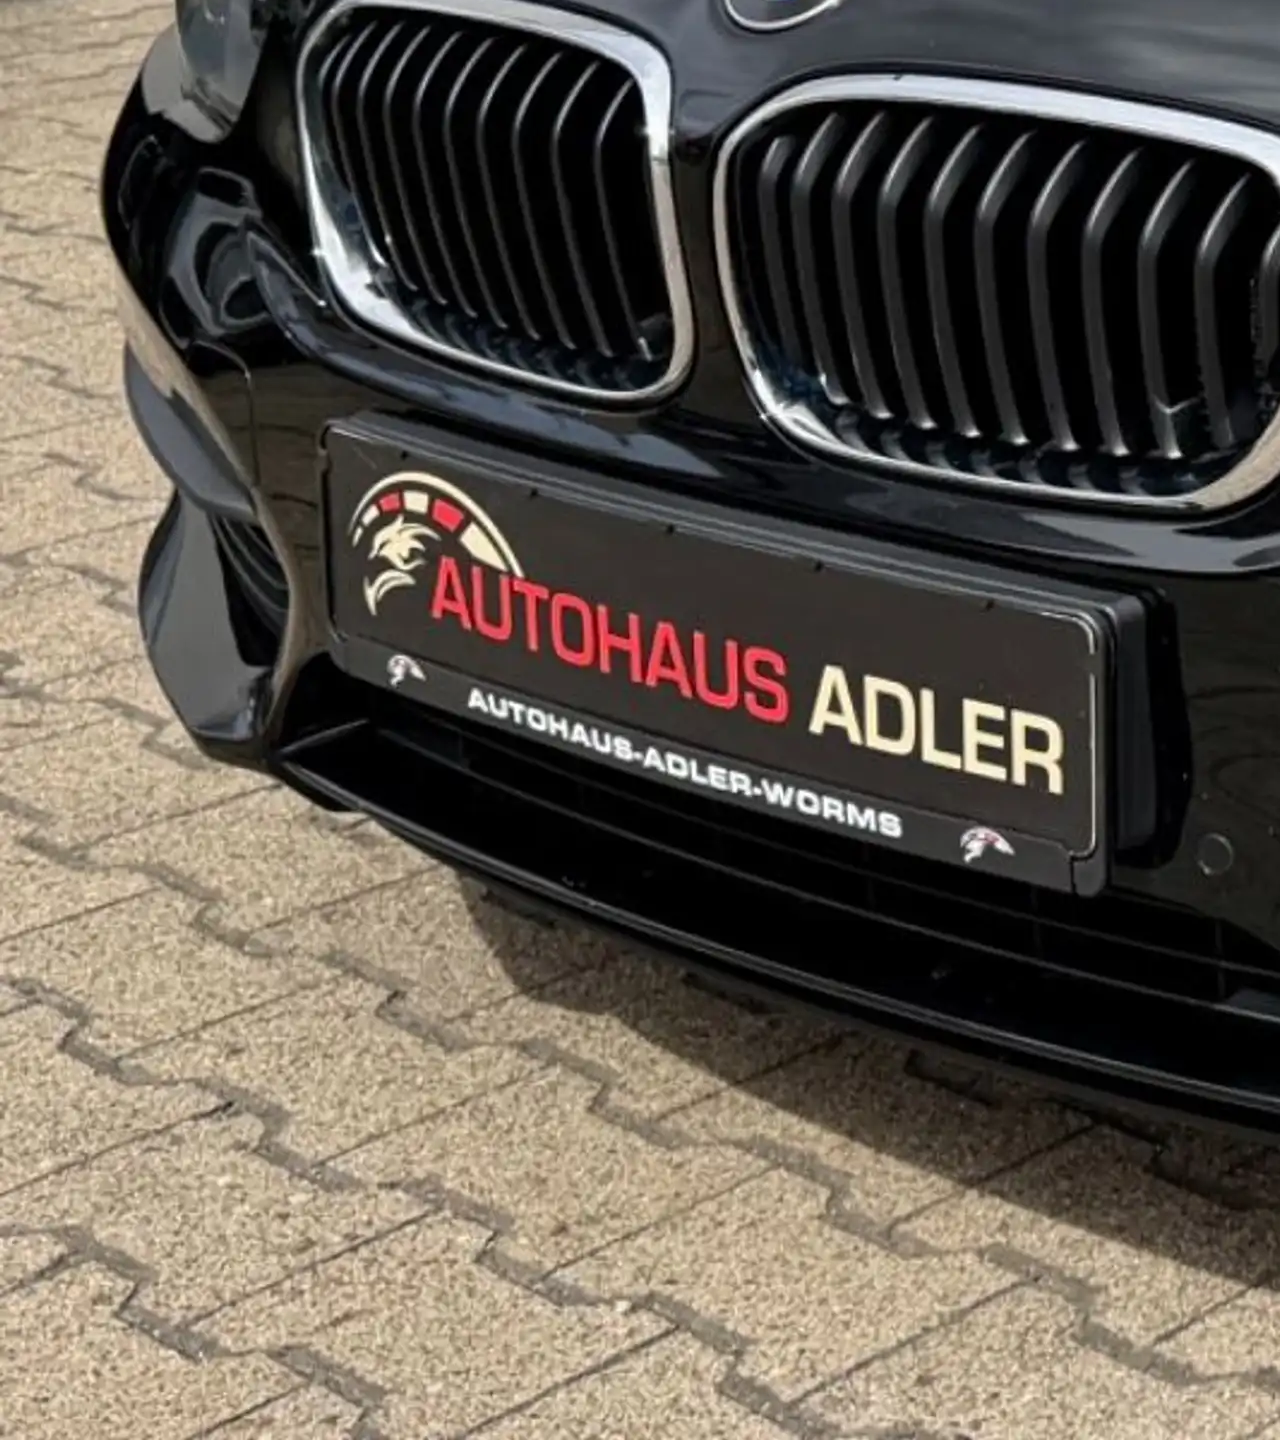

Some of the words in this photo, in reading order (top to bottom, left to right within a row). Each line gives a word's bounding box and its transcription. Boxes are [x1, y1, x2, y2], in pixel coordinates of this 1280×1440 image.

[430, 555, 790, 723] AUTOHAUS
[807, 664, 1064, 795] ADLER
[467, 687, 904, 839] AUTOHAUS-ADLER-WORMS
